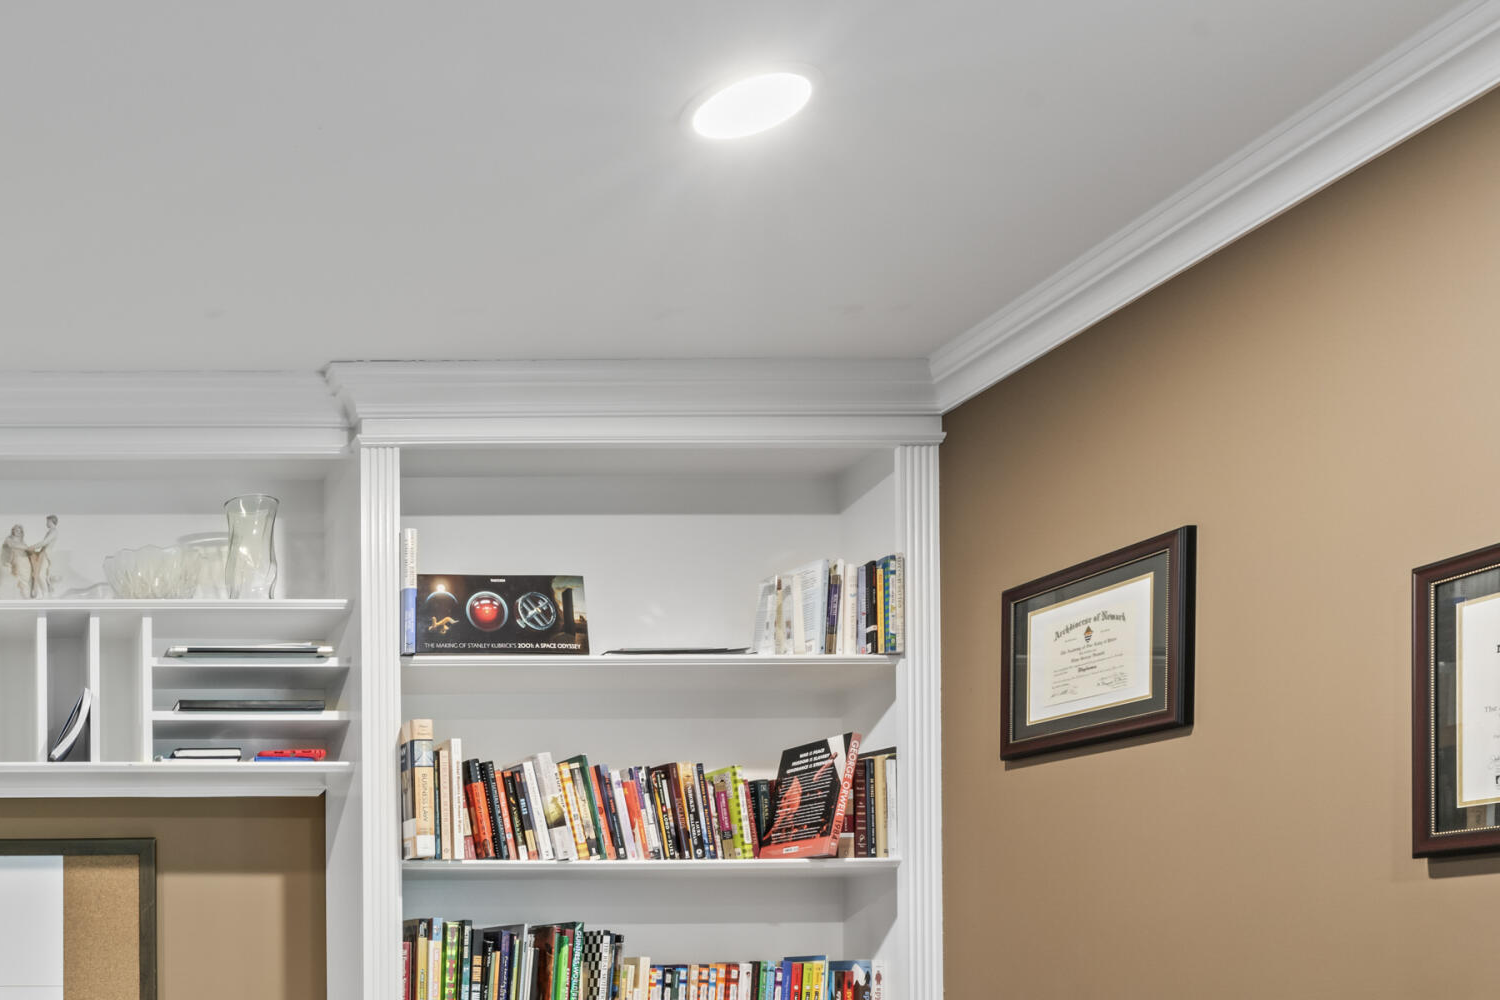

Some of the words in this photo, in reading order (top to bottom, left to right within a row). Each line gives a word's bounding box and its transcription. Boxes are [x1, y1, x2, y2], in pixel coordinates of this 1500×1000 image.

[844, 740, 859, 779] GEORGE
[836, 781, 851, 816] ORWELL
[831, 819, 842, 840] 1984
[574, 930, 582, 965] GUINNESS
